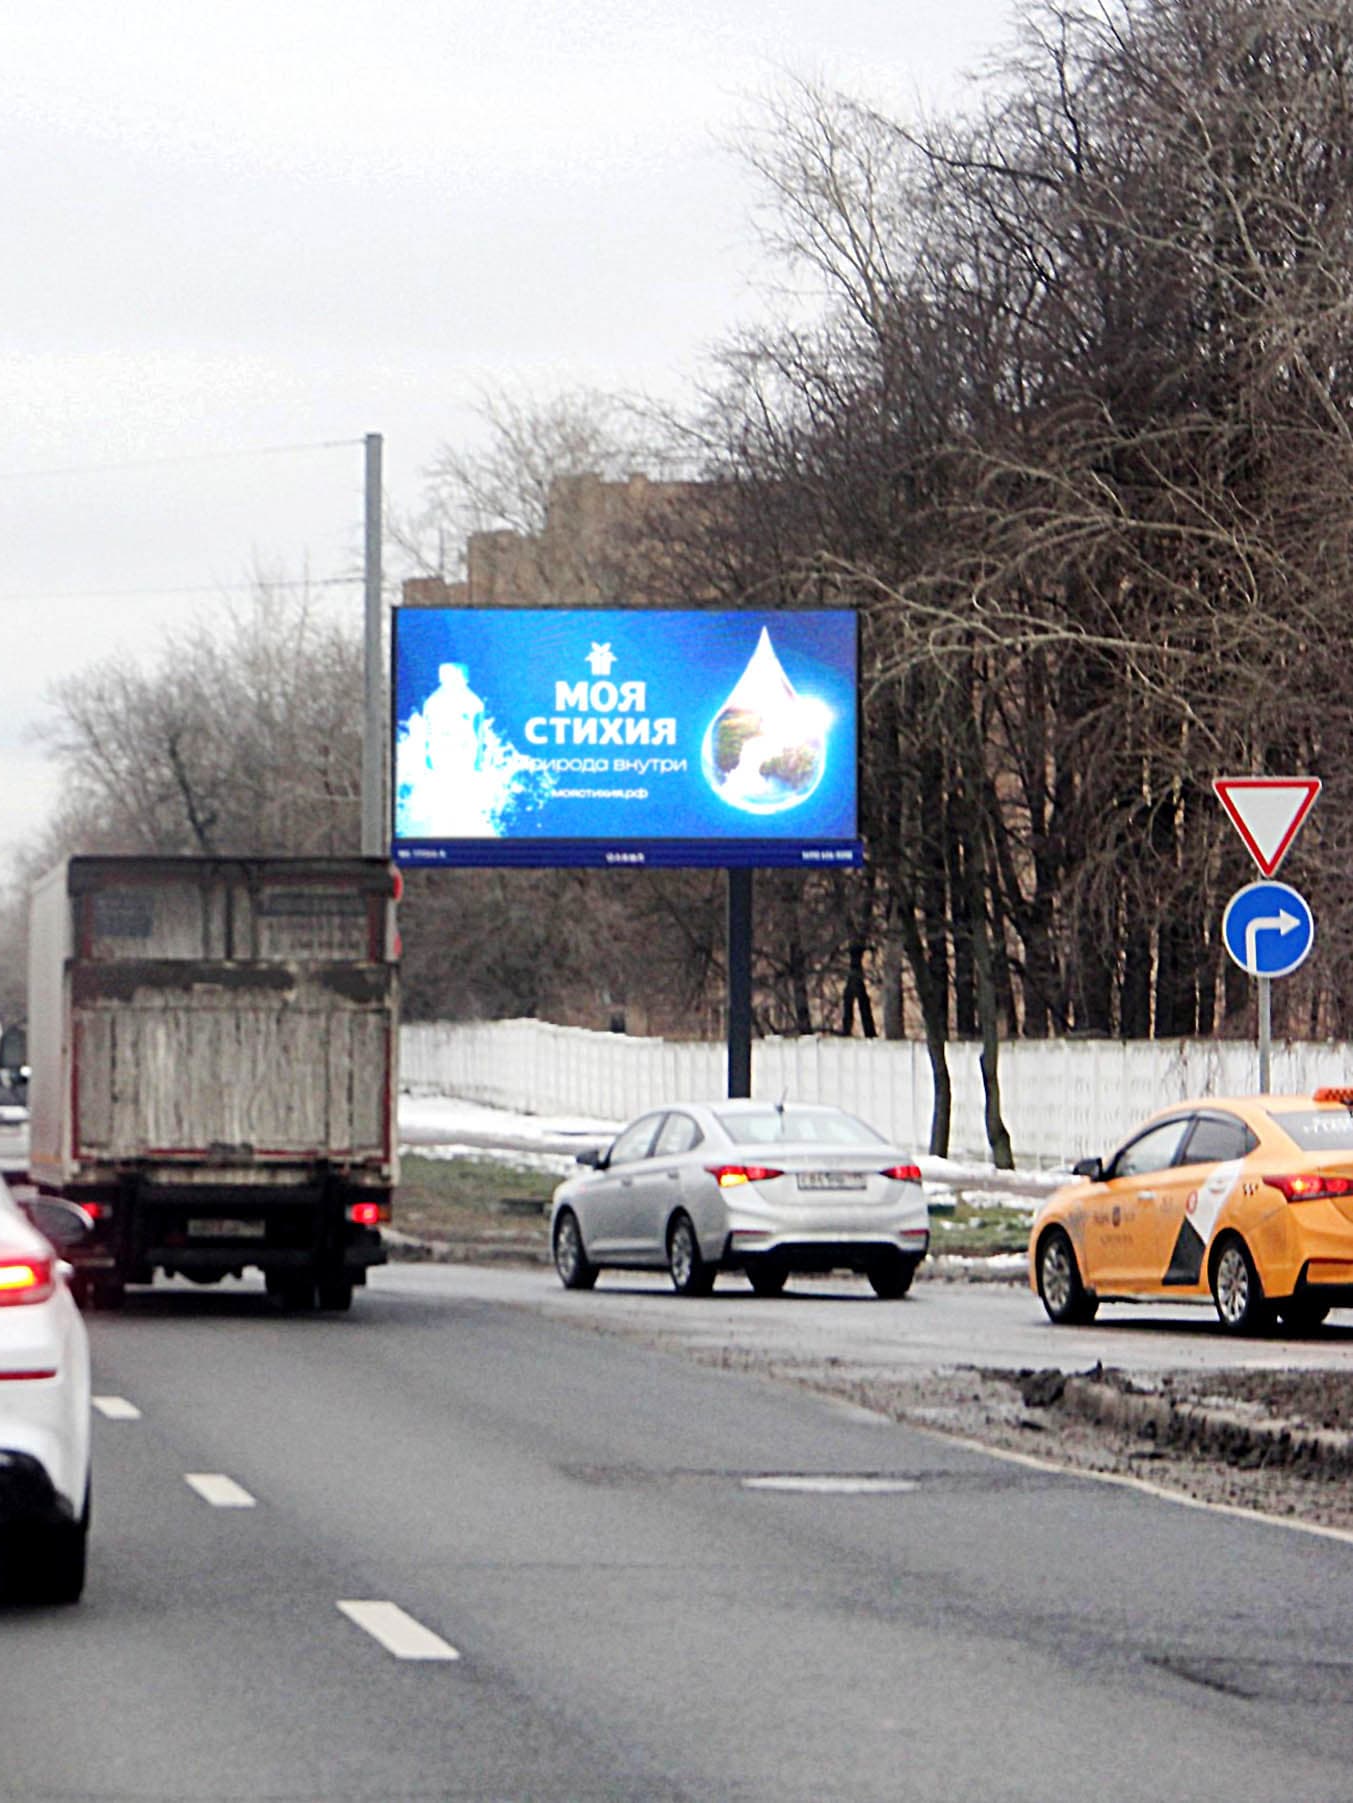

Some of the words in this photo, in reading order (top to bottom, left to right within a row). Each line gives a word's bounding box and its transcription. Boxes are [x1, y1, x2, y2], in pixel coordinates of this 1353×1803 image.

[554, 680, 646, 712] МОЯ
[524, 716, 677, 745] СТИХИЯ
[521, 757, 609, 773] рирода
[613, 757, 688, 774] внутри
